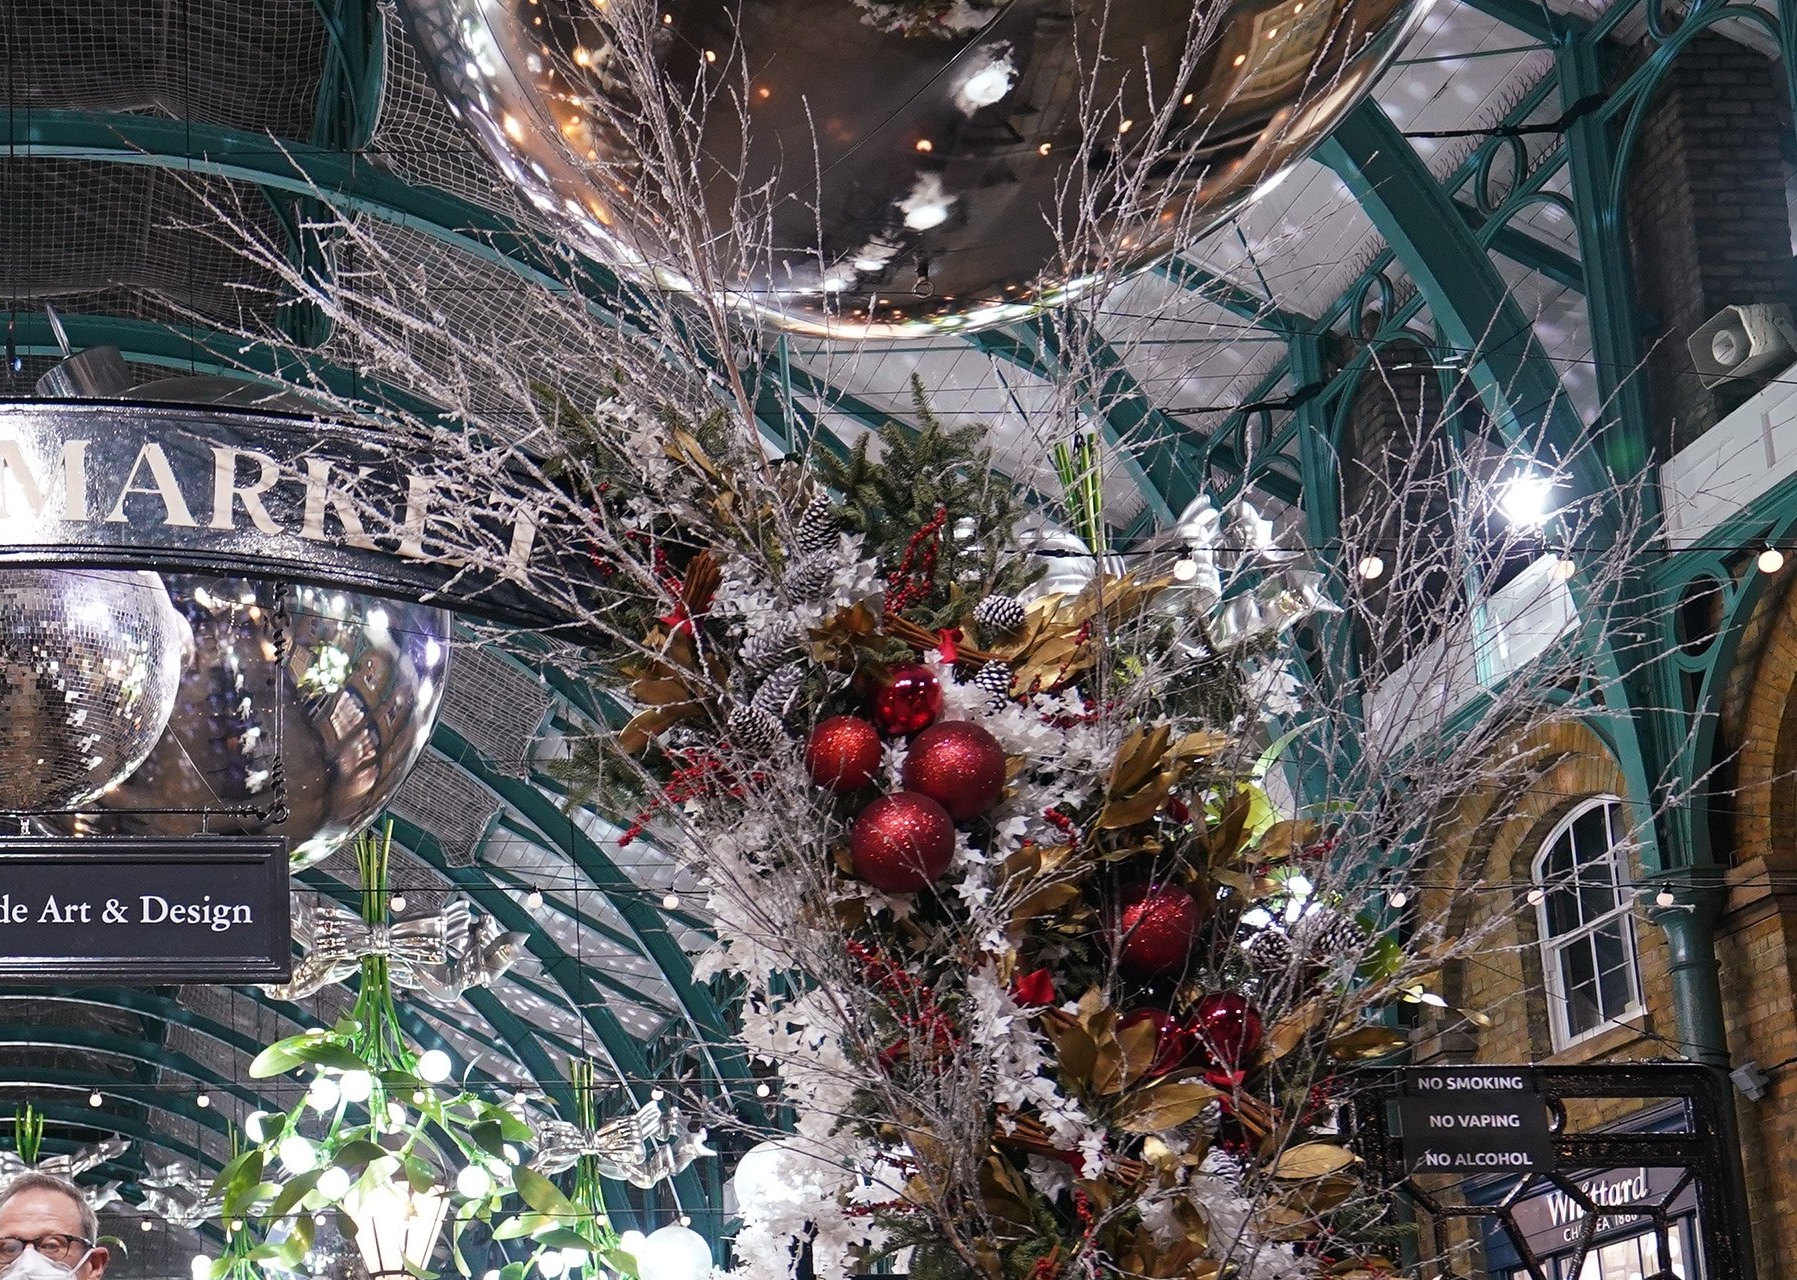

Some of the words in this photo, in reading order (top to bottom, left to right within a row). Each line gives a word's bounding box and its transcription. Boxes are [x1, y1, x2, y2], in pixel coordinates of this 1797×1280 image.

[37, 895, 91, 925] Art
[101, 898, 129, 924] &
[138, 894, 253, 932] Design
[1418, 1077, 1443, 1090] NO
[1446, 1076, 1524, 1090] SMOKING
[1429, 1115, 1455, 1128] NO
[1457, 1114, 1521, 1128] VAPING
[1425, 1153, 1451, 1166] NO
[1454, 1152, 1533, 1166] ALCOHOL
[1563, 1218, 1611, 1242] CHEA
